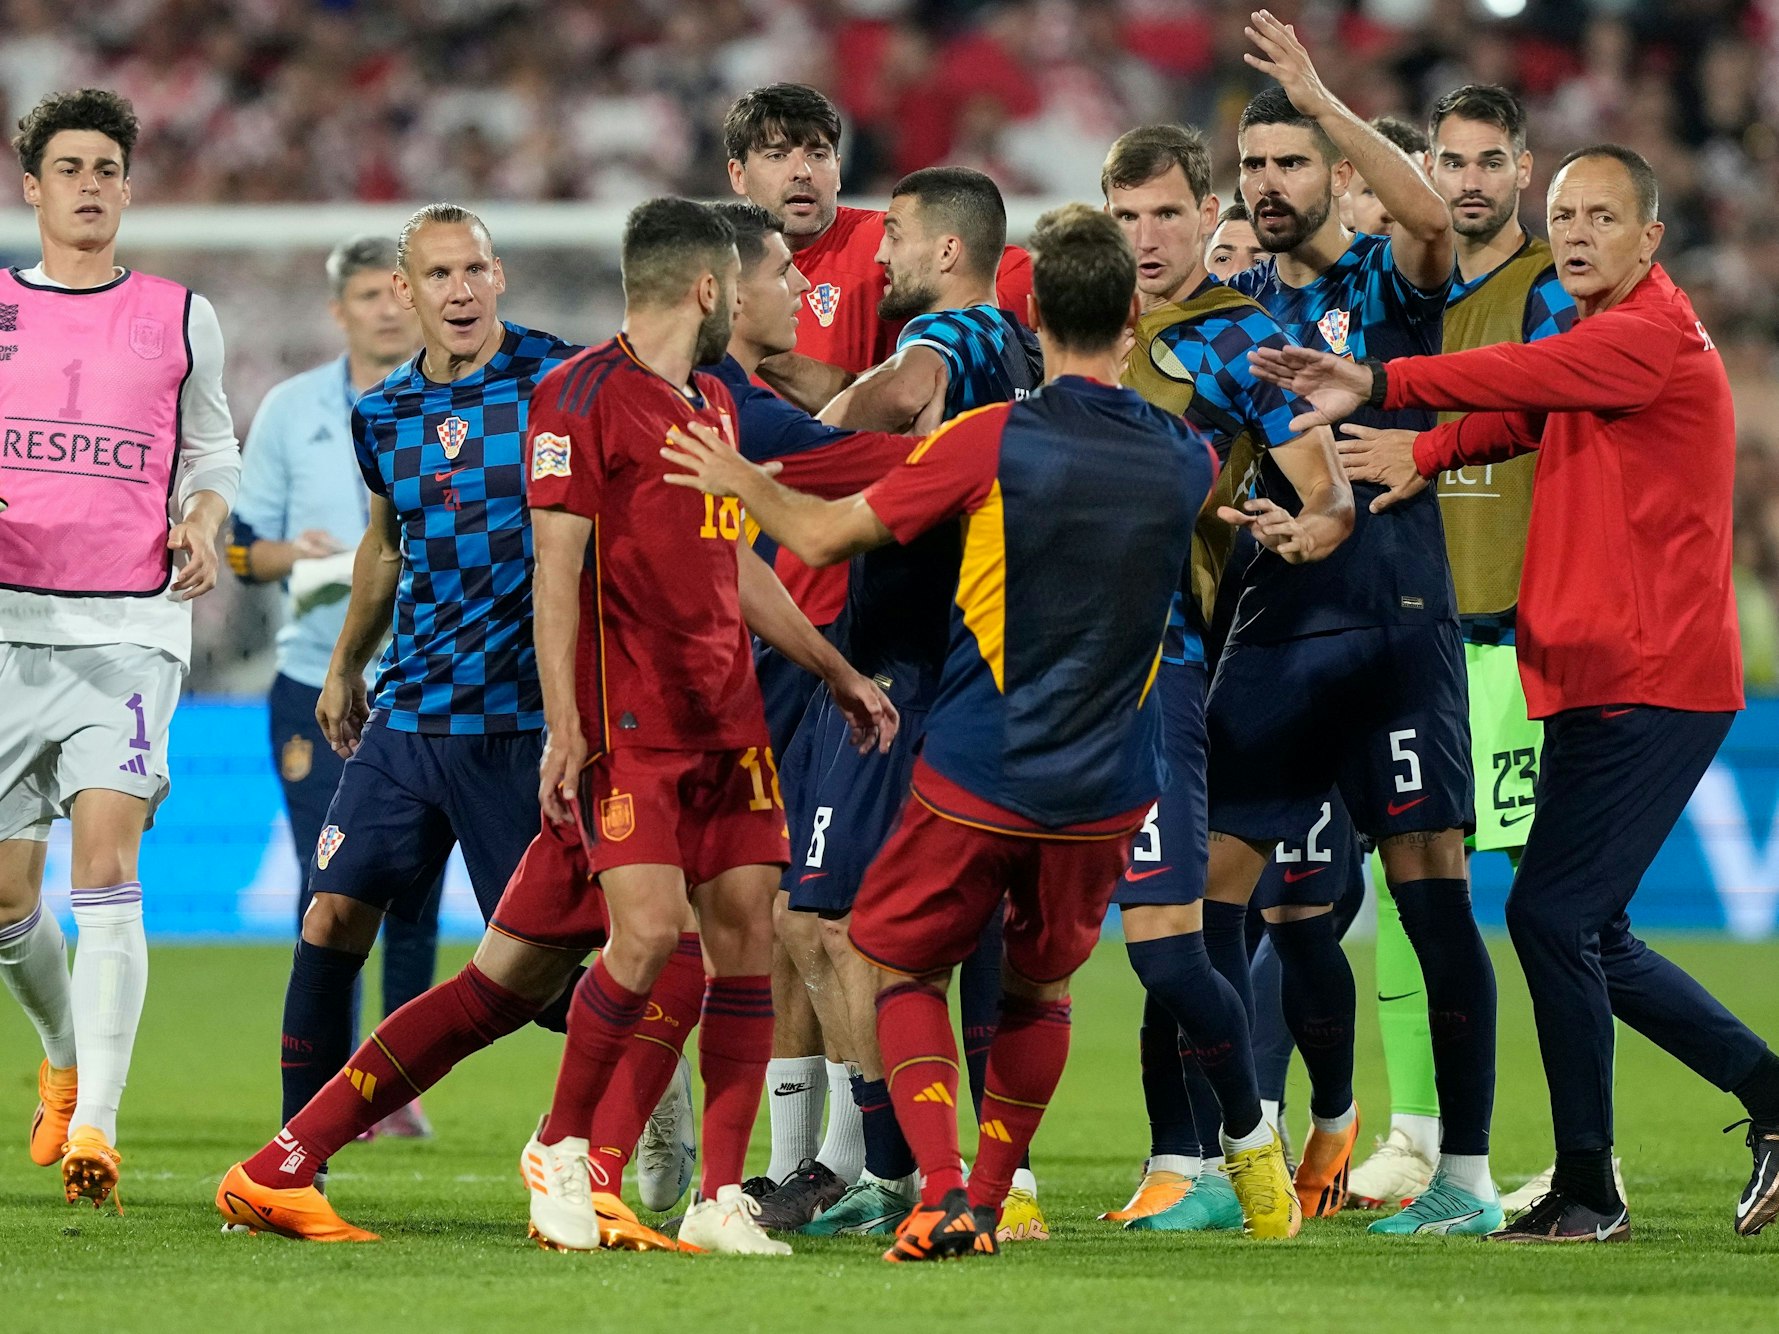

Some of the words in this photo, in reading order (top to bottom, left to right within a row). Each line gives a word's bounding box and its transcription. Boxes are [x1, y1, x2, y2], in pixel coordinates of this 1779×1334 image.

[3, 429, 152, 471] RESPECT
[442, 488, 461, 511] 21
[125, 692, 151, 751] 1
[1389, 728, 1422, 792] 5
[1493, 746, 1537, 810] 23
[805, 806, 834, 868] 8
[780, 1082, 806, 1091] NIKE
